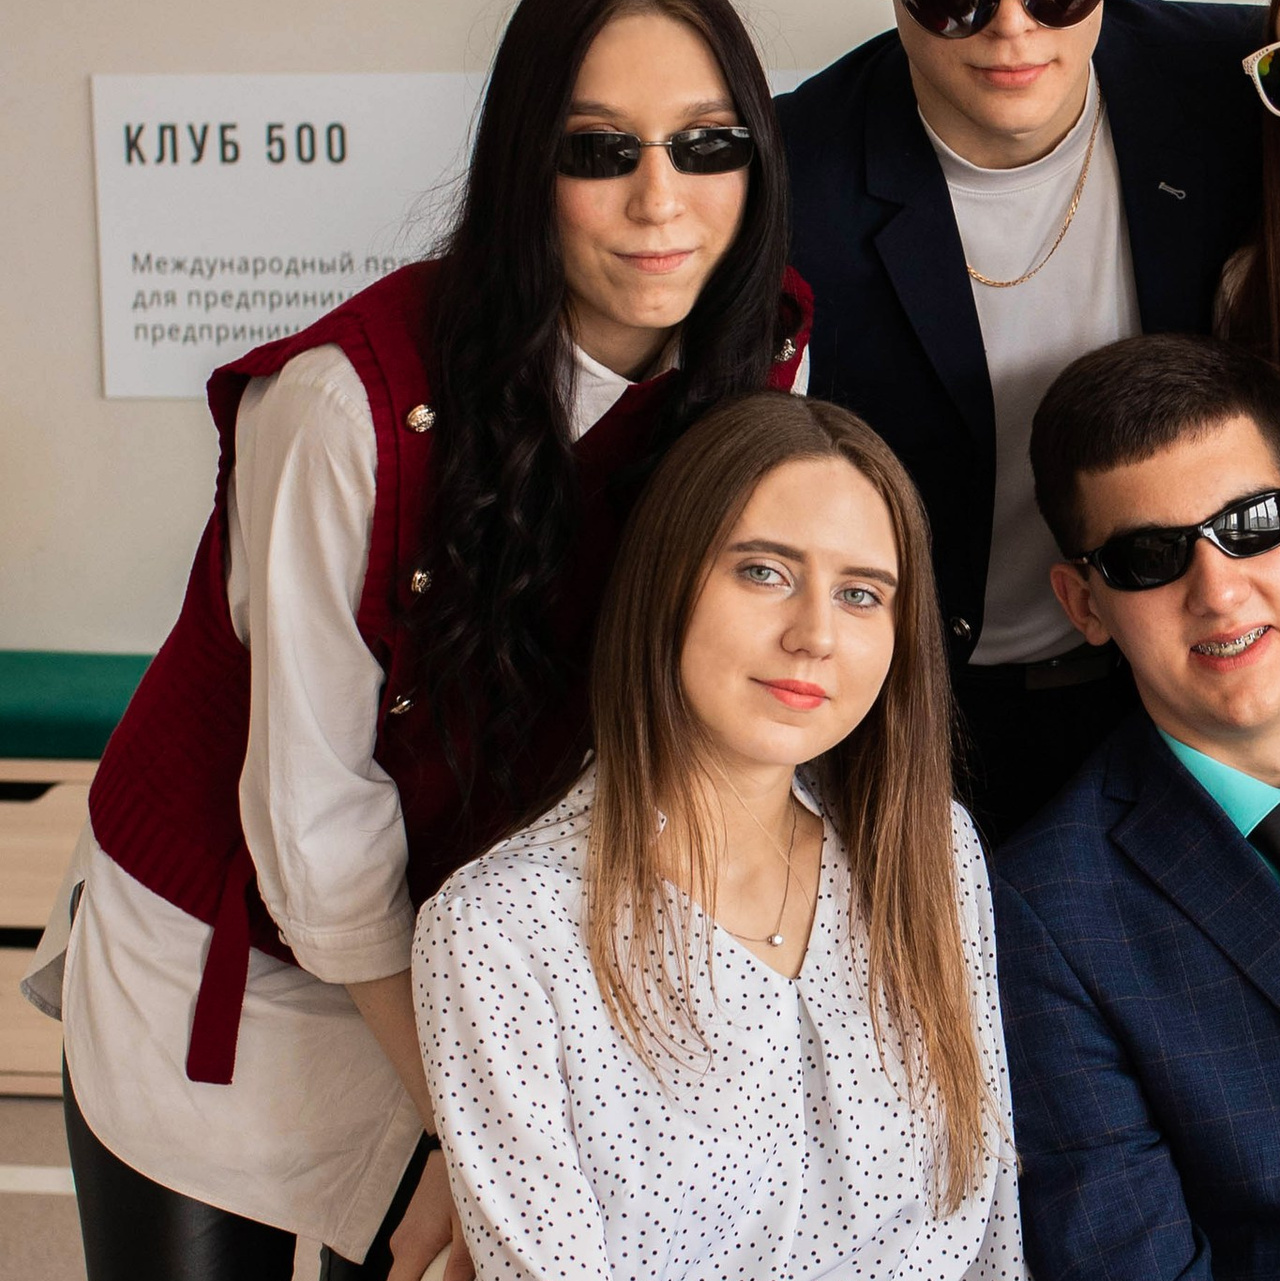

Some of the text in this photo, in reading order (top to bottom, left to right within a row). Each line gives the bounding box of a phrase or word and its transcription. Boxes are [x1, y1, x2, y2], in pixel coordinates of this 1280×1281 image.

[124, 123, 348, 166] КЛУБ 500
[132, 251, 355, 279] Международный
[132, 290, 177, 313] для
